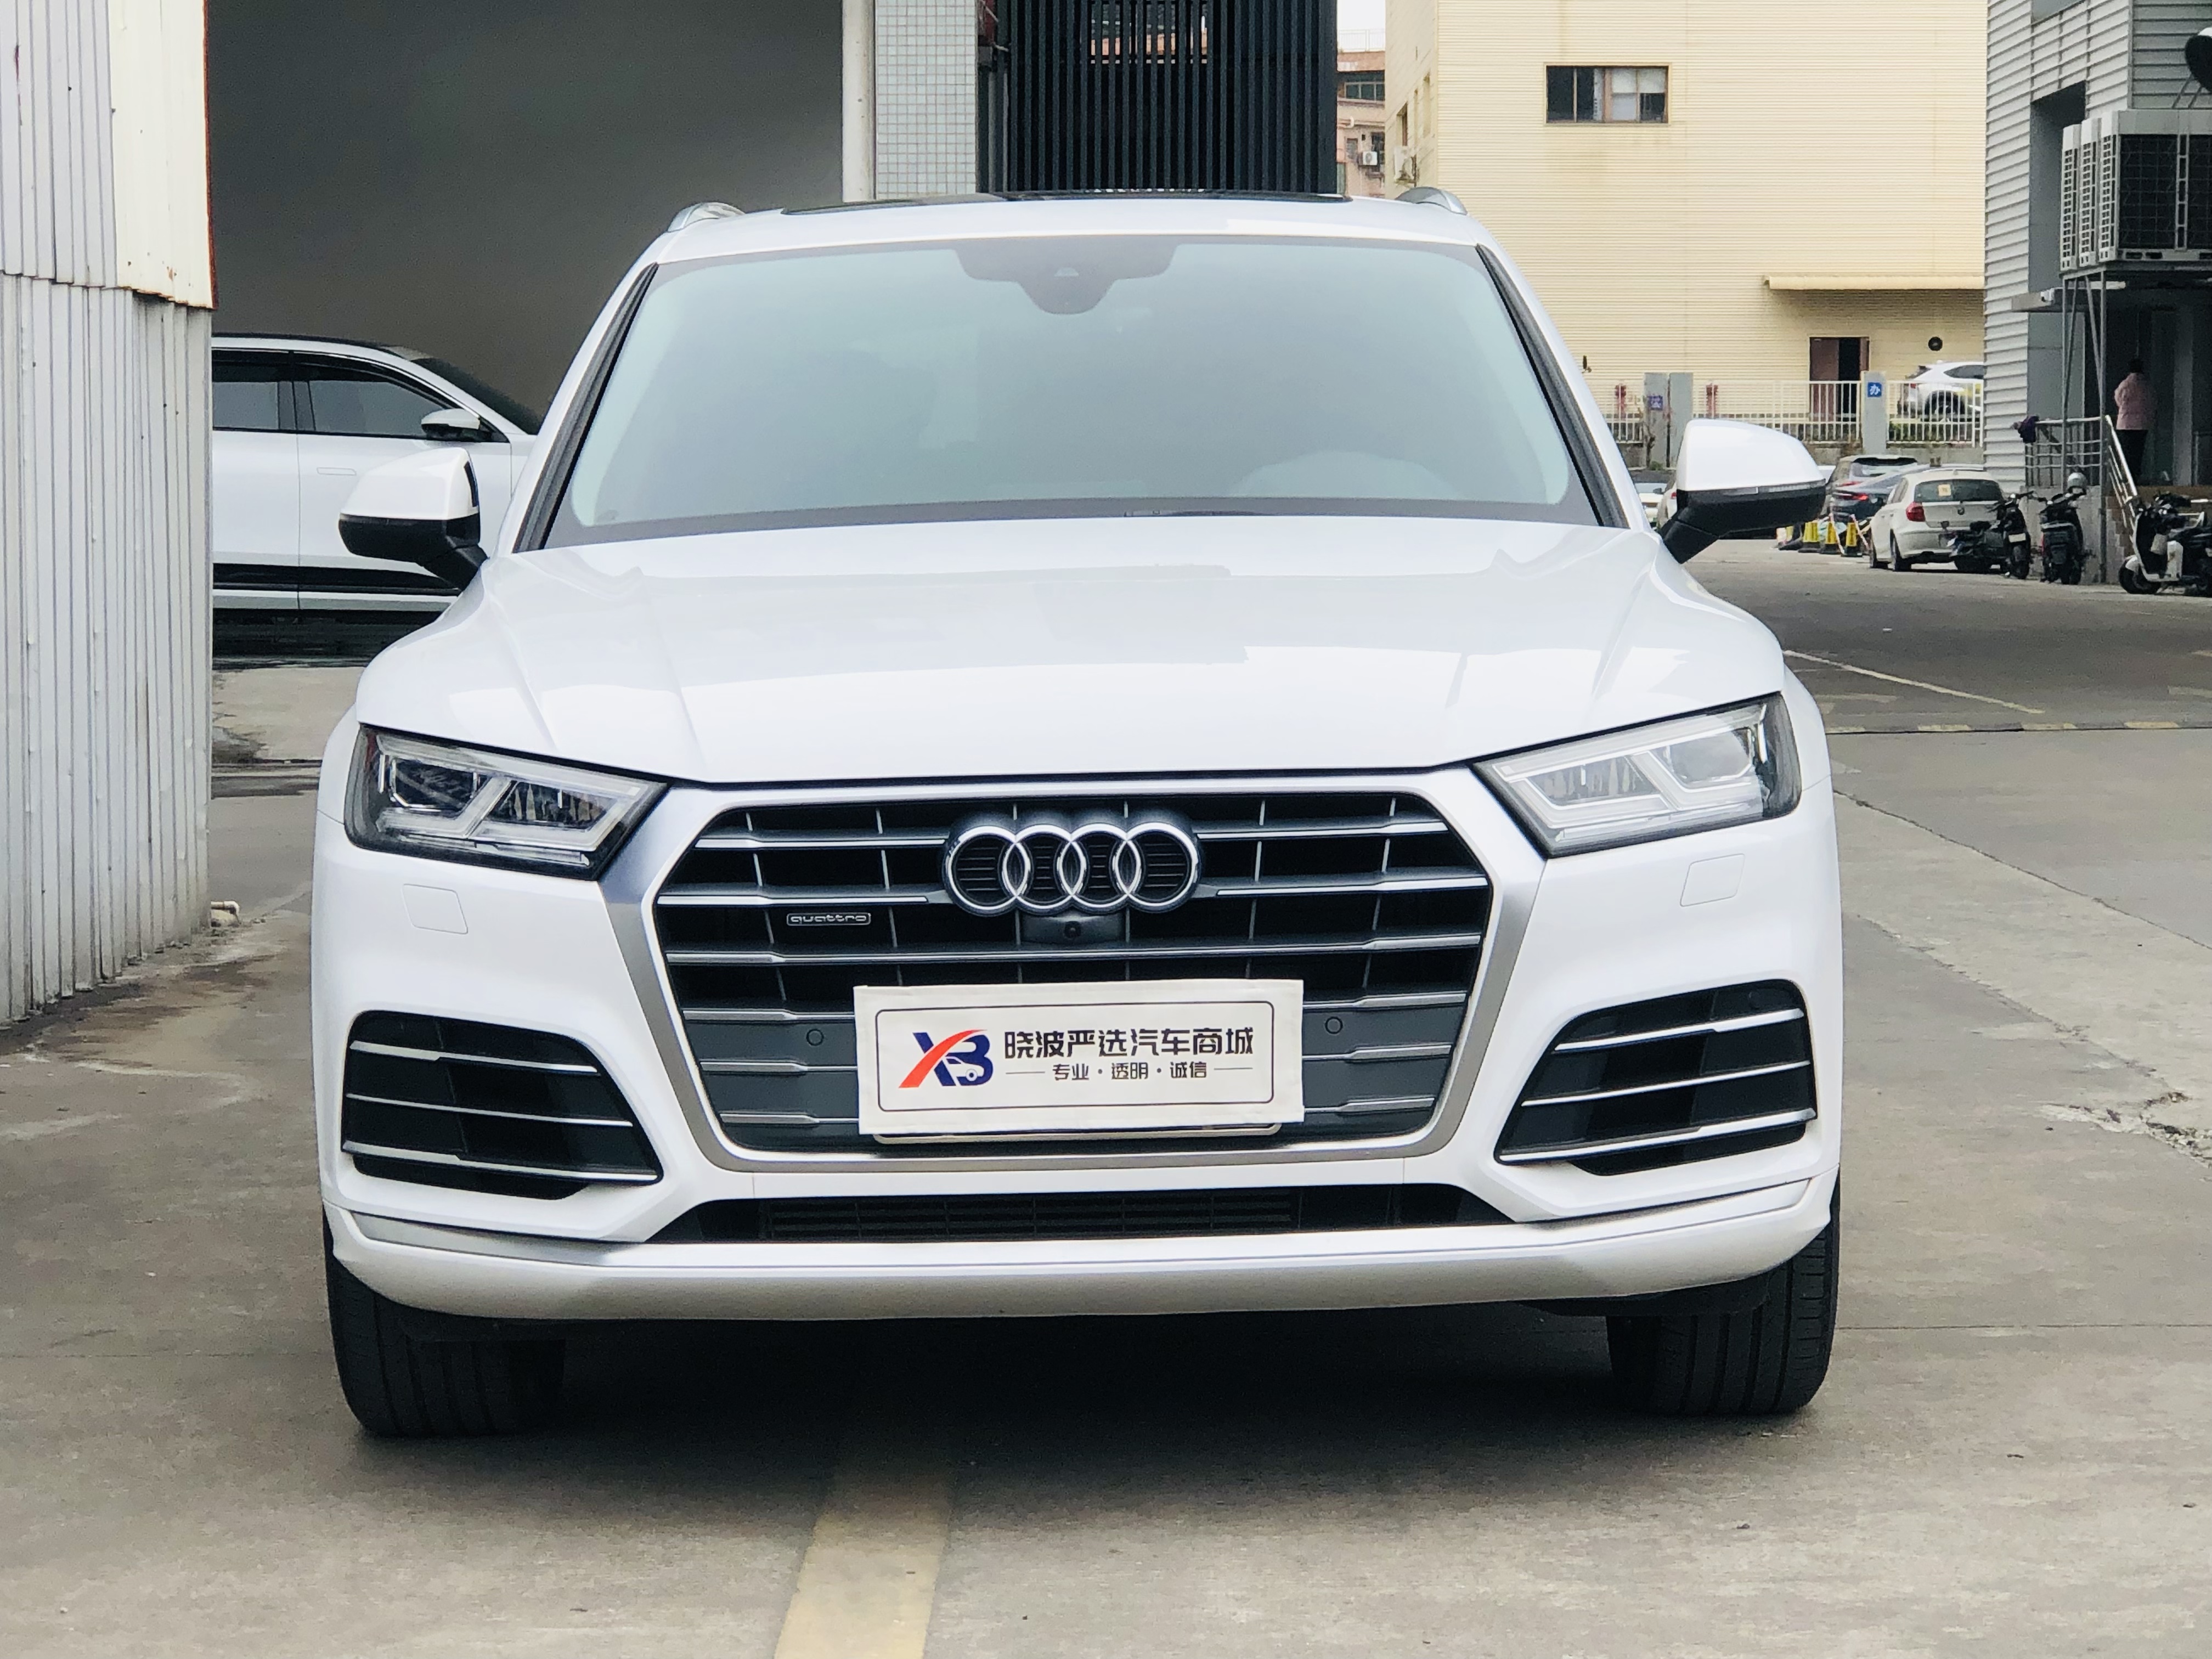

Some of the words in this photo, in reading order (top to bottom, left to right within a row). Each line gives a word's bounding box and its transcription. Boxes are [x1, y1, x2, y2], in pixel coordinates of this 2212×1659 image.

[791, 915, 867, 924] quattro
[1003, 1026, 1254, 1059] 晓波严选汽车商城
